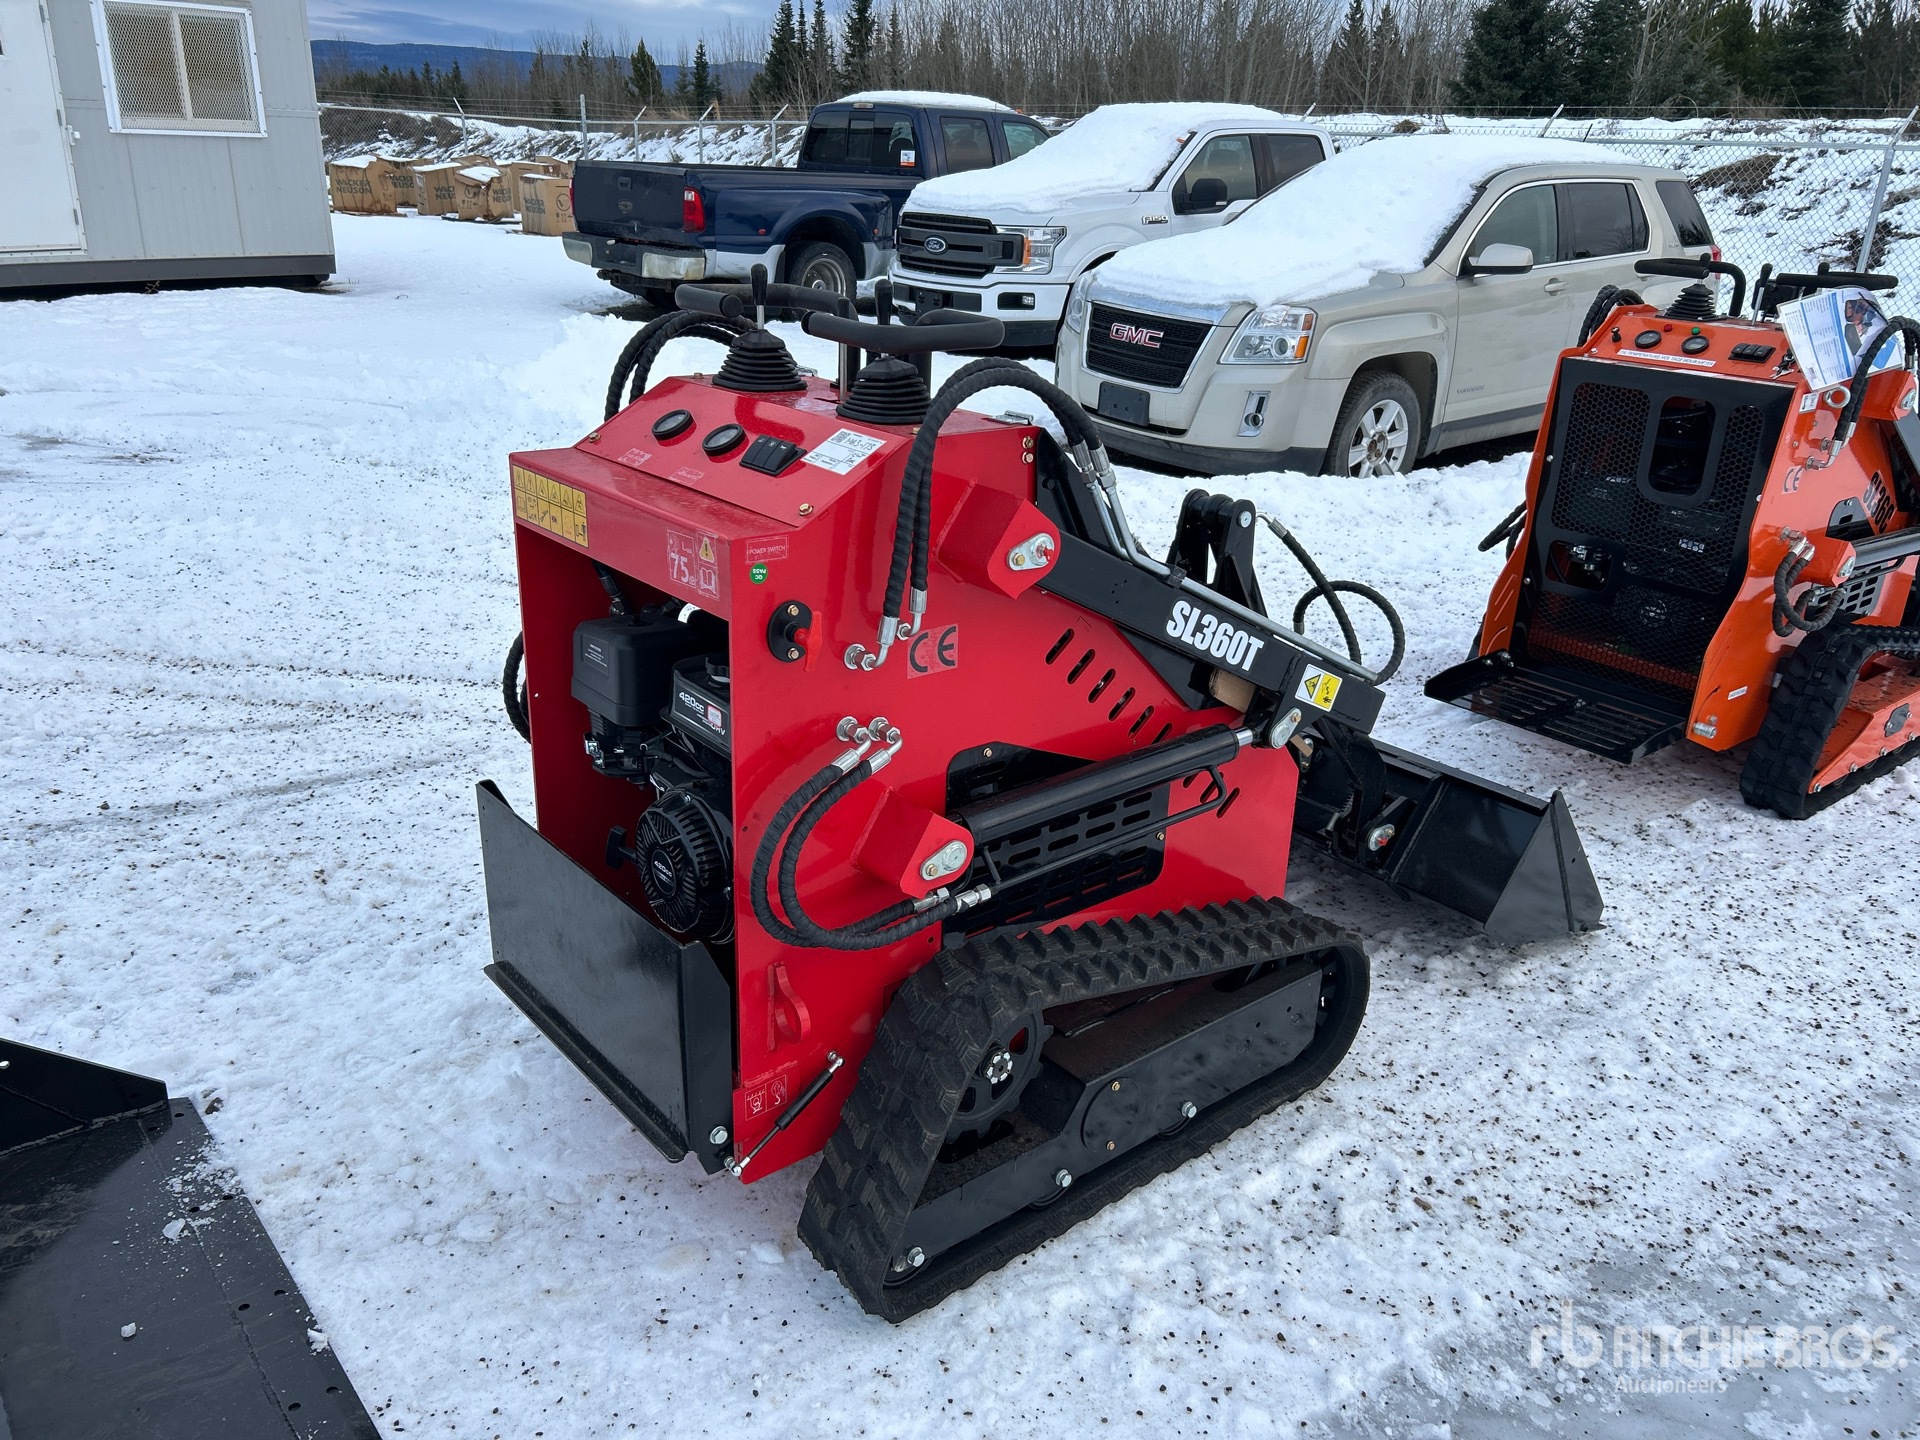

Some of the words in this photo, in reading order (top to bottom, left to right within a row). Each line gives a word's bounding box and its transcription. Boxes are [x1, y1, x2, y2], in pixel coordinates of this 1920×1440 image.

[335, 179, 370, 187] WACKER
[336, 186, 372, 194] NEUSON
[1110, 322, 1164, 349] GMC
[749, 547, 766, 555] POWER
[670, 552, 689, 583] 75
[1166, 600, 1264, 671] SL360T
[909, 625, 957, 673] CE
[679, 692, 704, 711] 420cc
